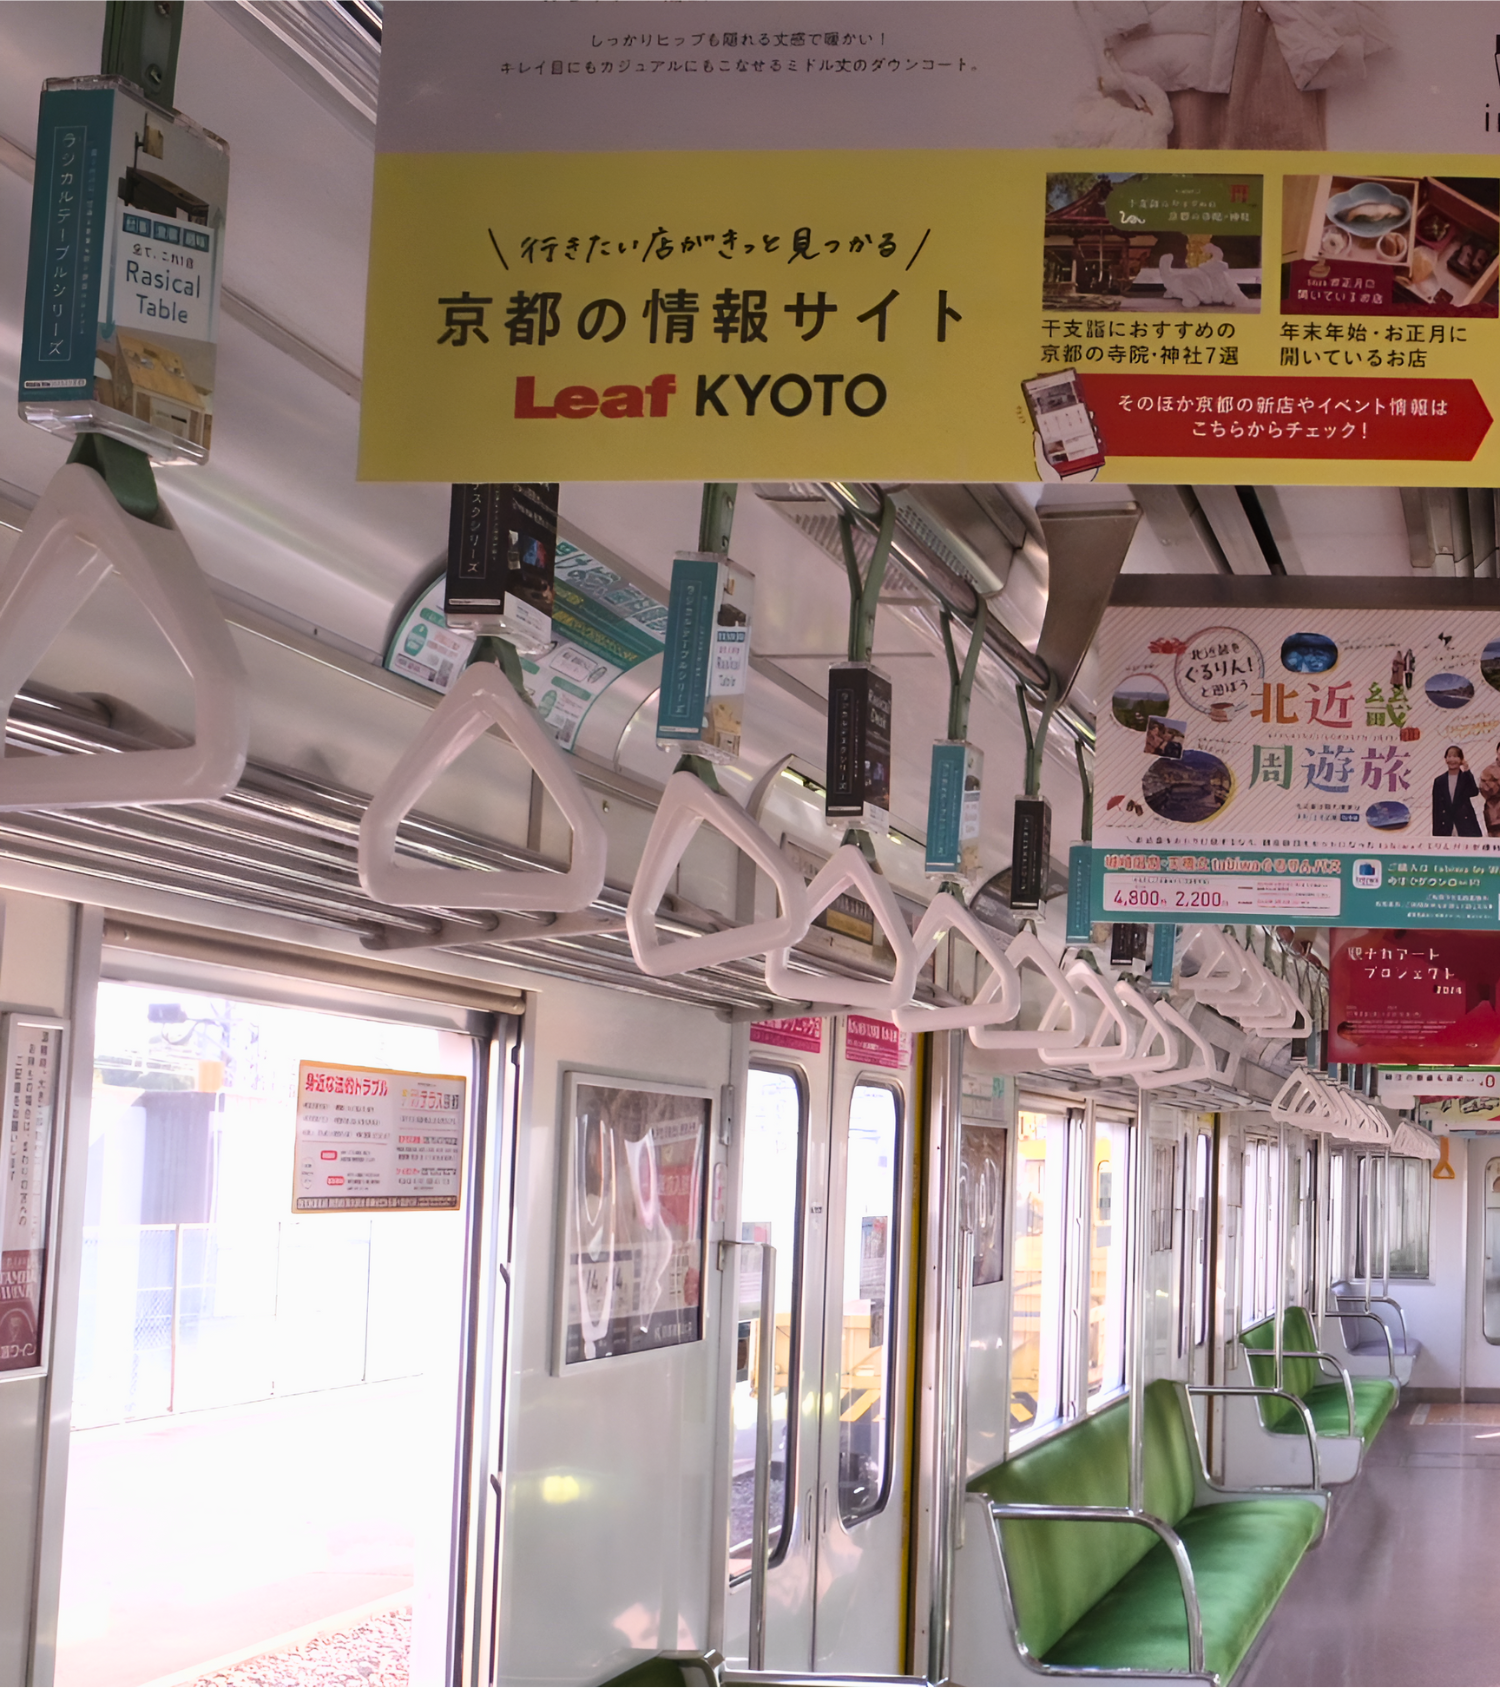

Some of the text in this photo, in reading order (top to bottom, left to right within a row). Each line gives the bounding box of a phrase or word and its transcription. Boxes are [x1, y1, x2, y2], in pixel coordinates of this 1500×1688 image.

[49, 133, 76, 356] ラシカルテーブルシリーズ
[519, 226, 898, 264] 行きたい店がきっと見つかる
[126, 259, 200, 299] Rasical
[135, 292, 189, 324] Table
[436, 288, 963, 347] 京都の情報サイト
[1040, 318, 1237, 341] 干支詣におすすめの
[1279, 320, 1468, 346] 年末年始・お正月に
[1279, 345, 1427, 368] 開いているお店
[513, 373, 887, 419] Leaf KYOTO
[1117, 394, 1450, 417] そのほか京都の新店やイベント情報は
[1191, 419, 1368, 441] こちらからチェック！
[1250, 681, 1412, 730] 北近畿
[1248, 743, 1413, 794] 周遊旅
